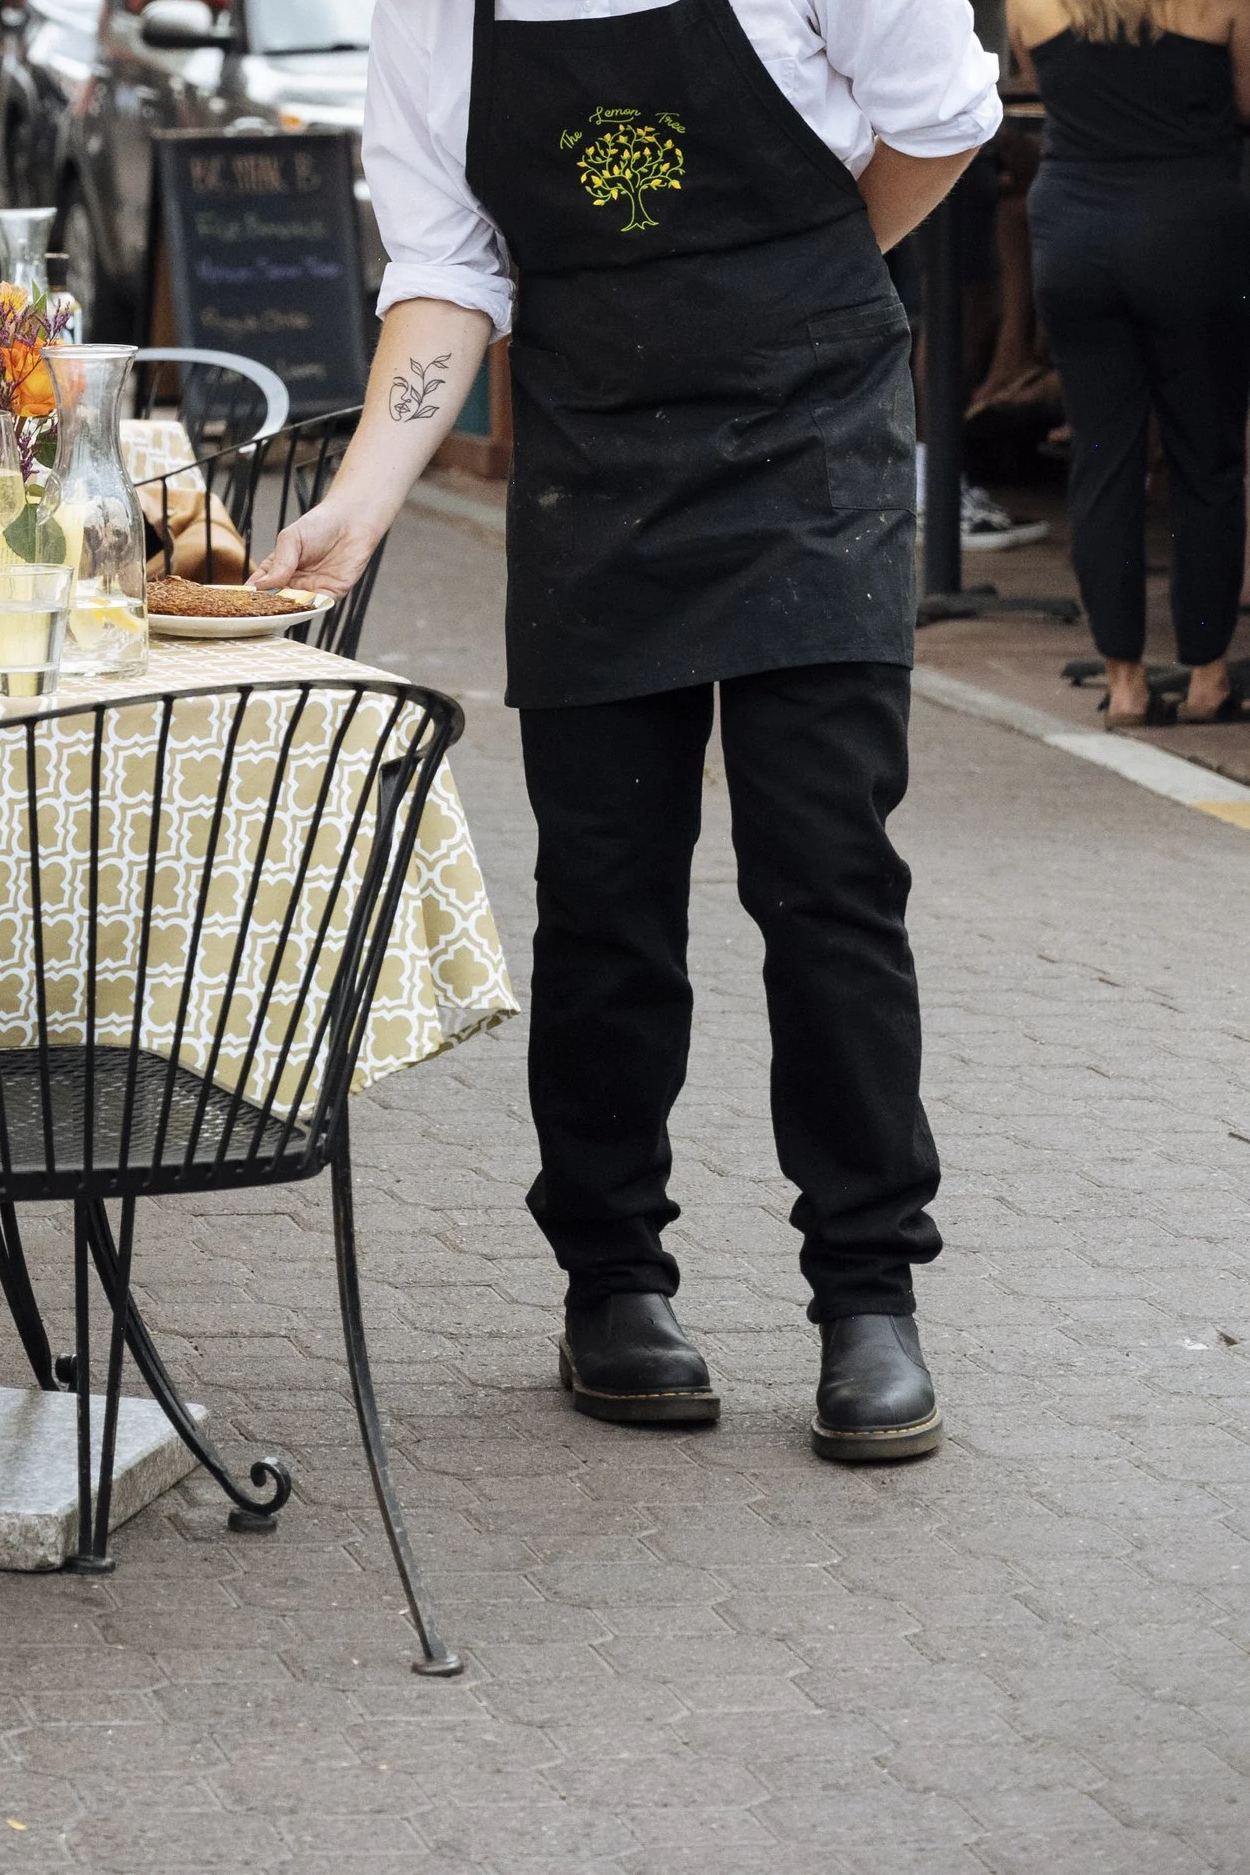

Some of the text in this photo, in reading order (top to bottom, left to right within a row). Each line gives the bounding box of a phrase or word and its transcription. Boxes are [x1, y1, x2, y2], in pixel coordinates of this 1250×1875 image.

[559, 106, 686, 149] The Lemon Tree
